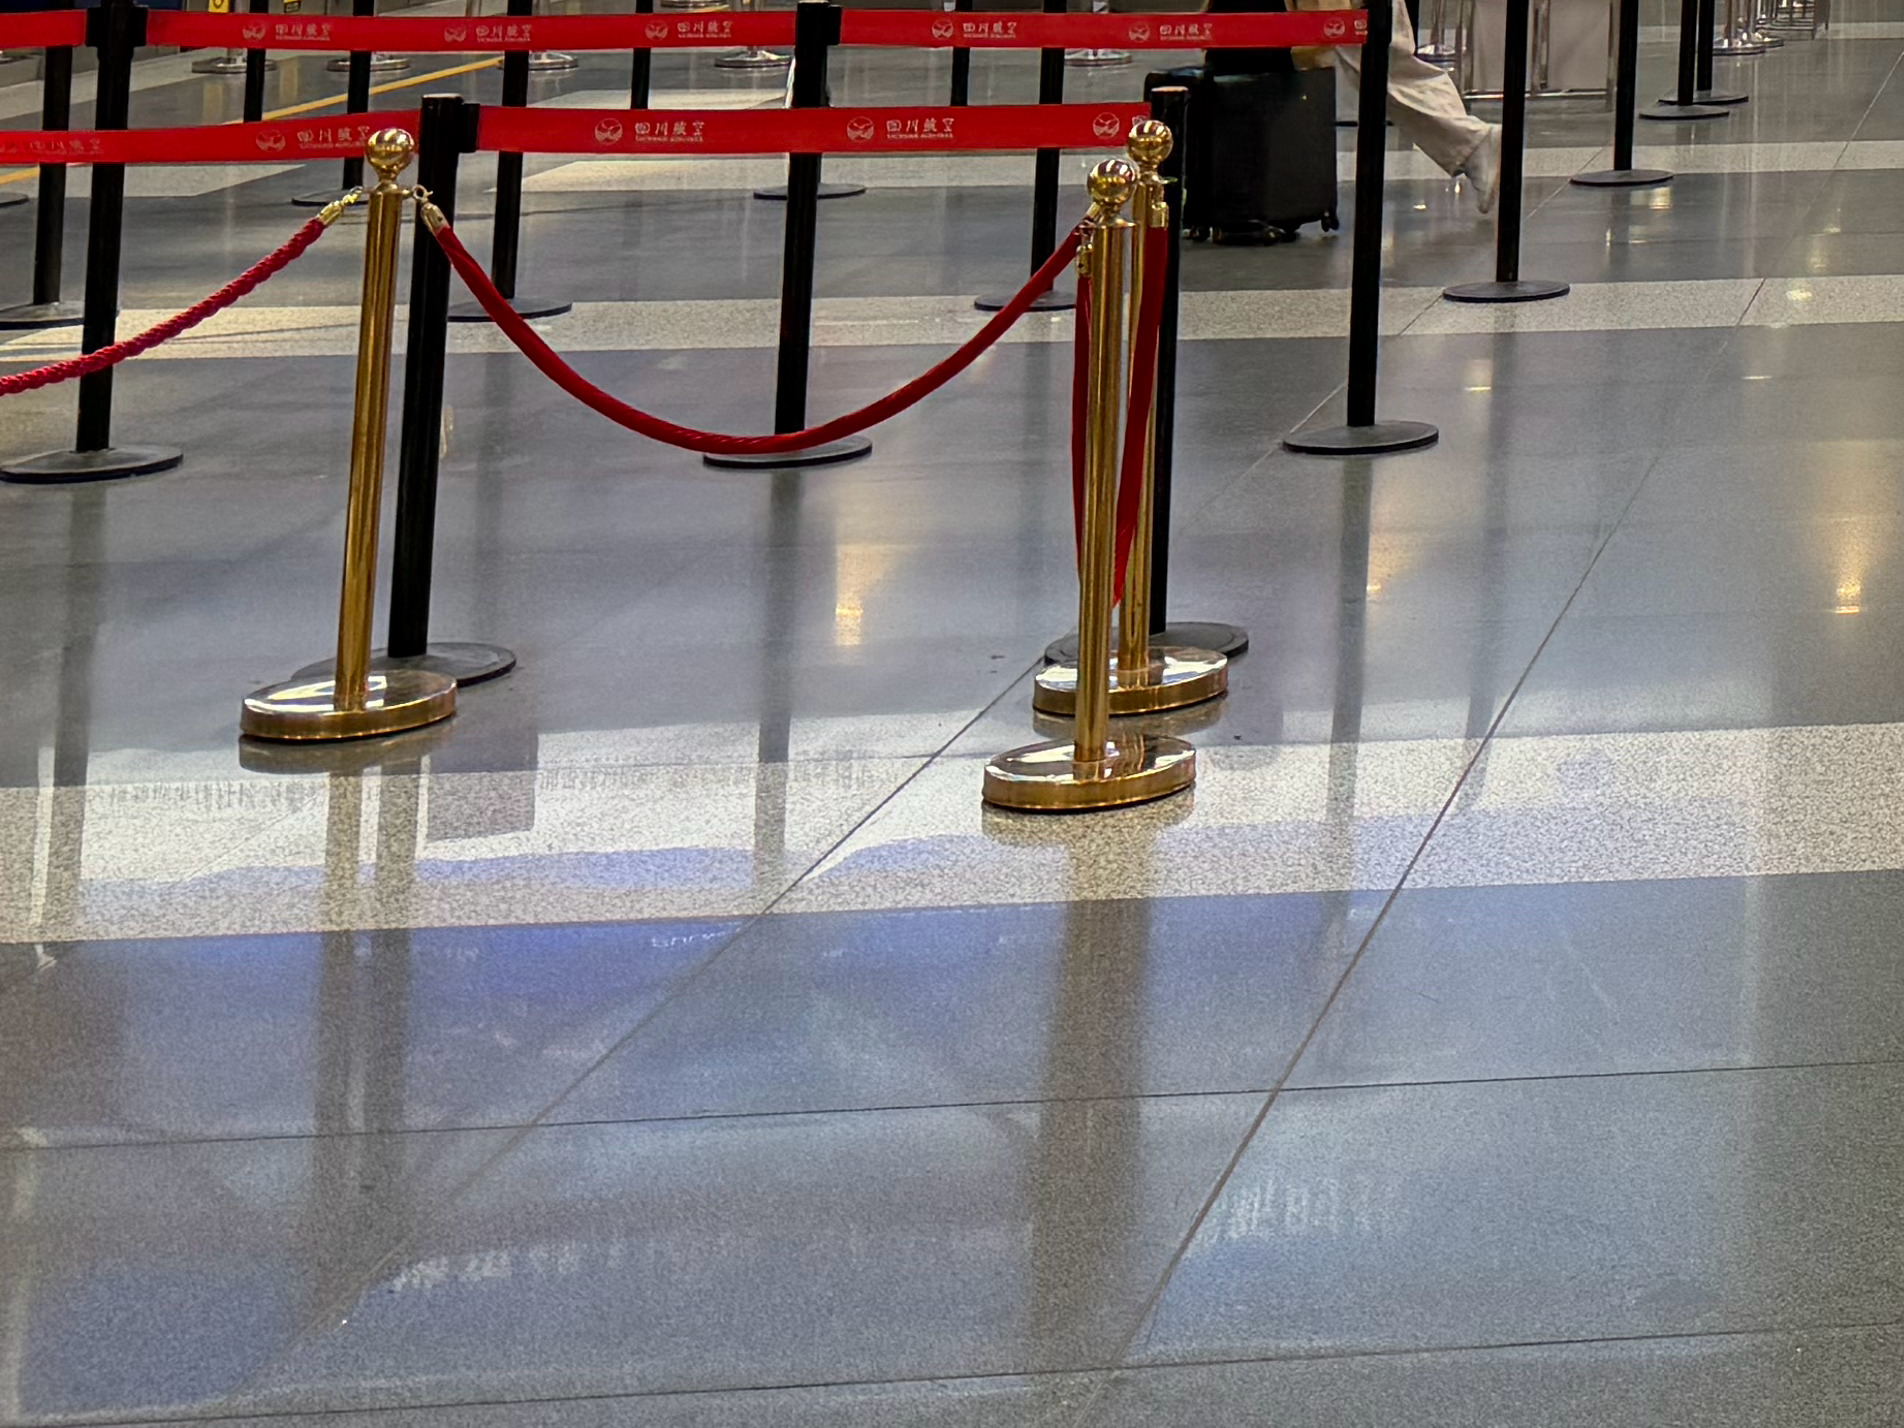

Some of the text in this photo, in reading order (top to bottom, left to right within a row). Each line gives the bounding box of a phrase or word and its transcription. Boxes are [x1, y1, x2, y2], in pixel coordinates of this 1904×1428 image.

[635, 121, 705, 136] 四川航空
[886, 118, 954, 133] 四川航空
